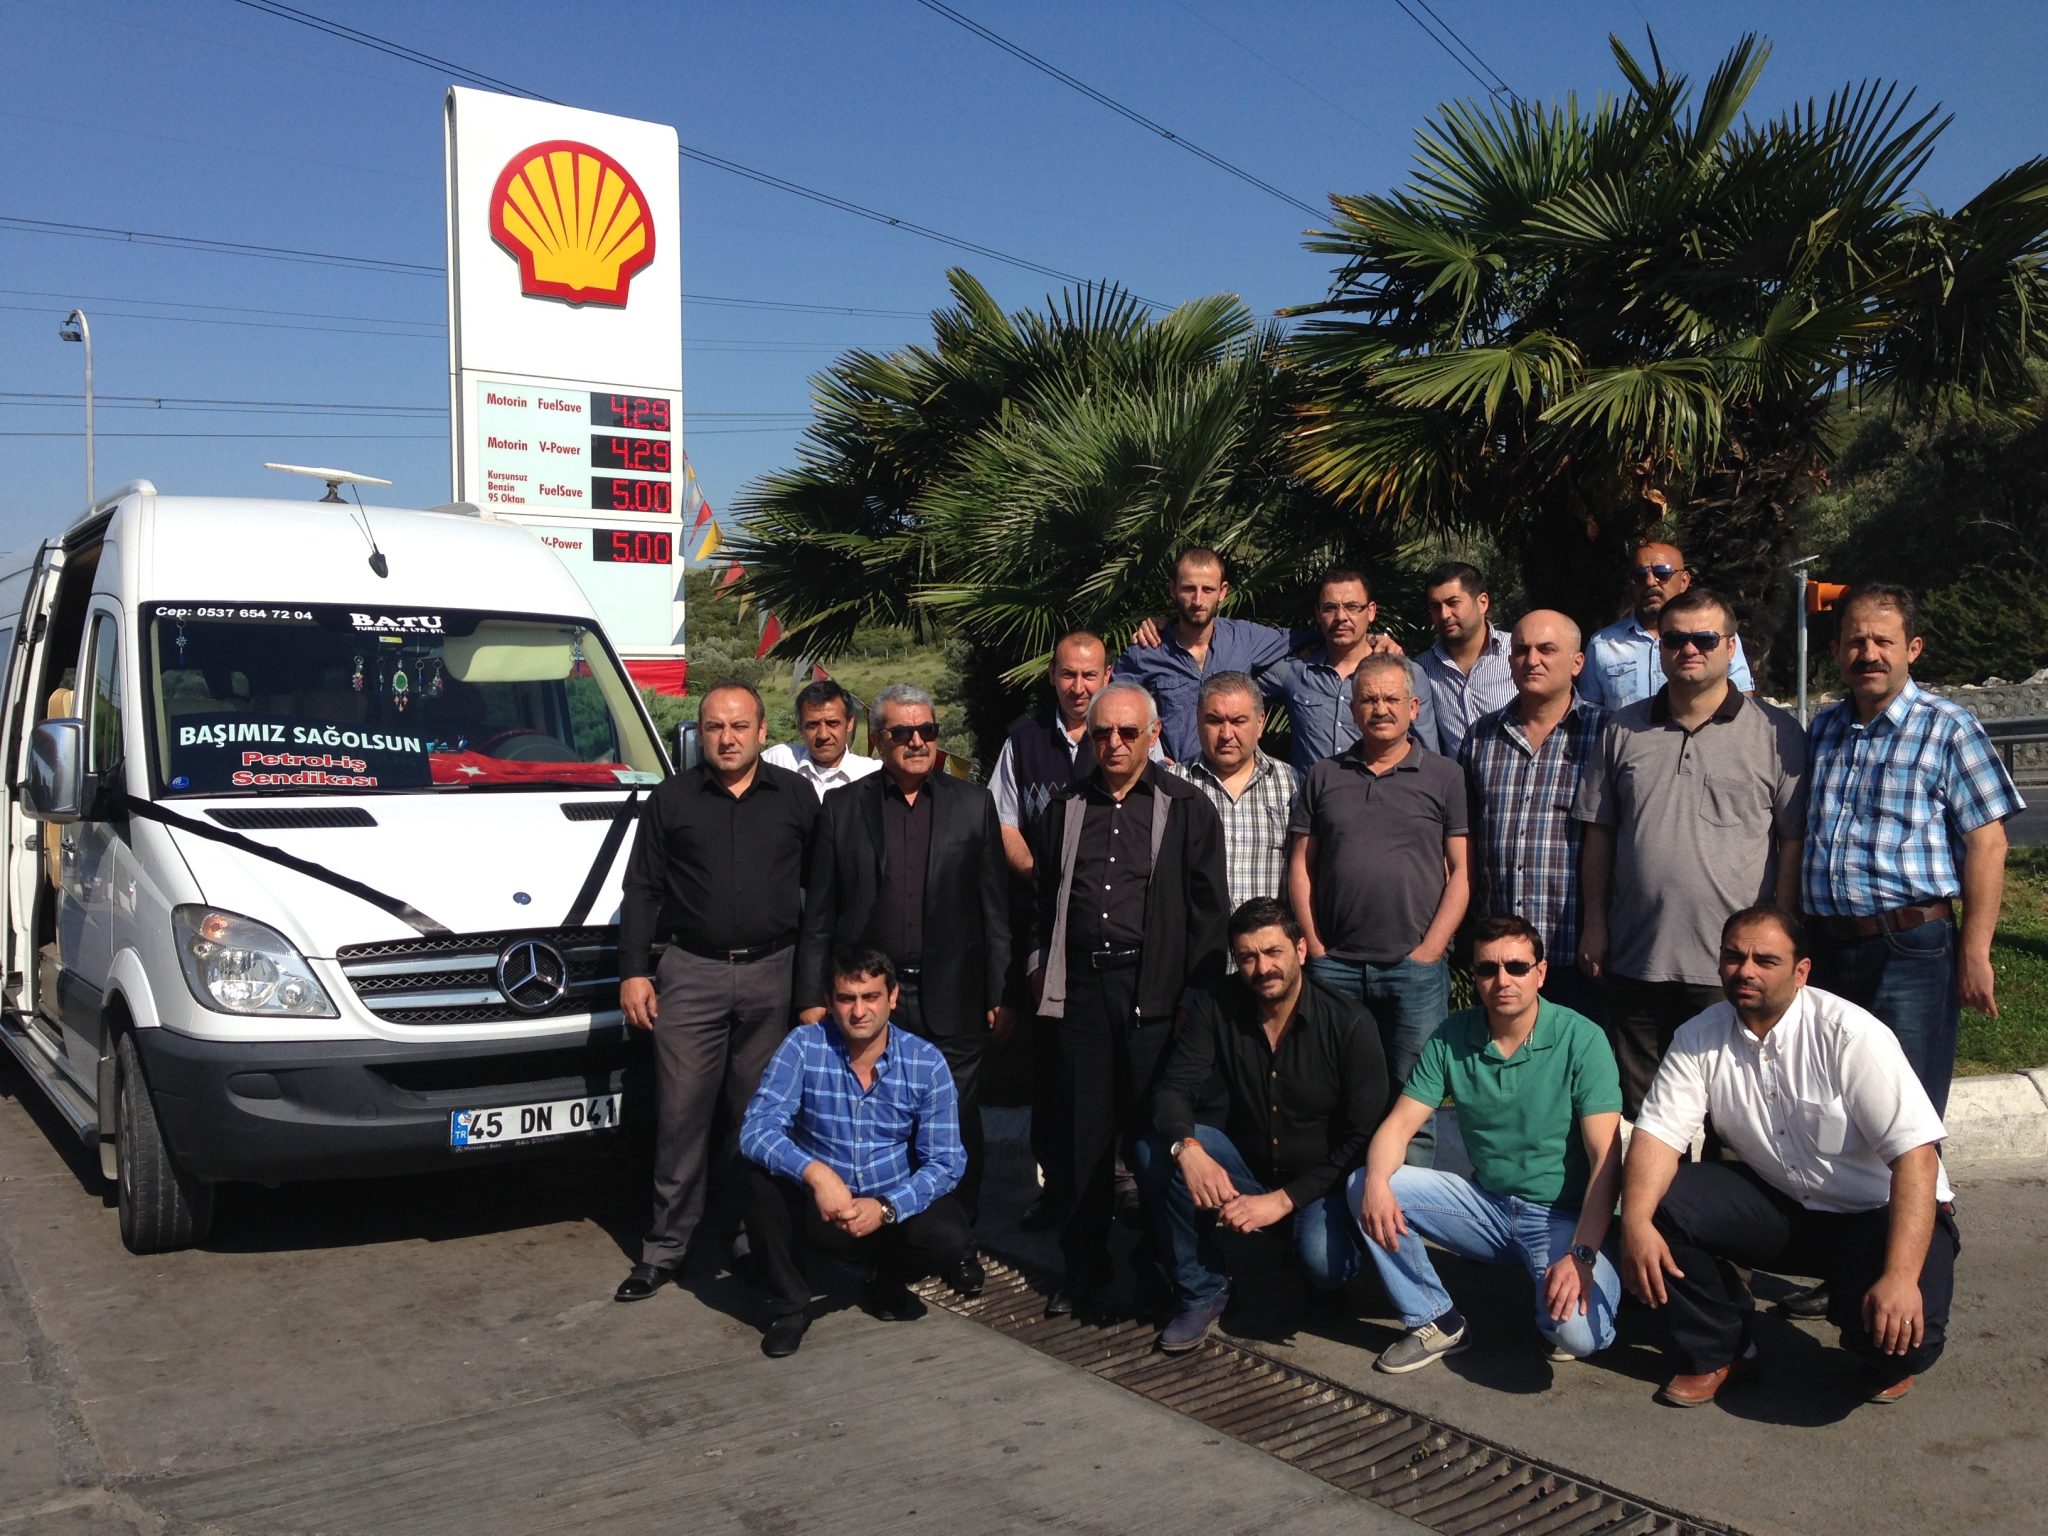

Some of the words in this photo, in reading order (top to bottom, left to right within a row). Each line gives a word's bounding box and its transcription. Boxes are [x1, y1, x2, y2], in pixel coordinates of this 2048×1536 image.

[486, 392, 528, 408] Motorin
[538, 397, 582, 413] FuelSave
[609, 395, 669, 430] 4.29
[487, 436, 528, 451] Motorin
[539, 440, 581, 456] V-Power
[611, 437, 669, 471] 4.29
[488, 481, 515, 492] Benzin
[539, 483, 583, 498] FuelSave
[612, 479, 671, 512] 5.00
[488, 492, 498, 502] 95
[501, 493, 525, 504] Oktan
[541, 536, 583, 550] V-Power
[612, 531, 671, 564] 5.00
[155, 606, 192, 618] Cep:
[196, 607, 235, 618] 0537
[239, 608, 267, 618] 654
[271, 609, 290, 619] 72
[294, 610, 313, 620] 04
[349, 612, 442, 629] BATU
[179, 723, 286, 748] BAŞIMIZ
[292, 725, 421, 753] SAĞOLSUN
[241, 751, 367, 773] Petrol-iş
[231, 770, 378, 788] Sendikası
[468, 1112, 503, 1139] 45
[520, 1105, 553, 1135] DN
[570, 1097, 616, 1128] 041
[455, 1129, 467, 1139] TR
